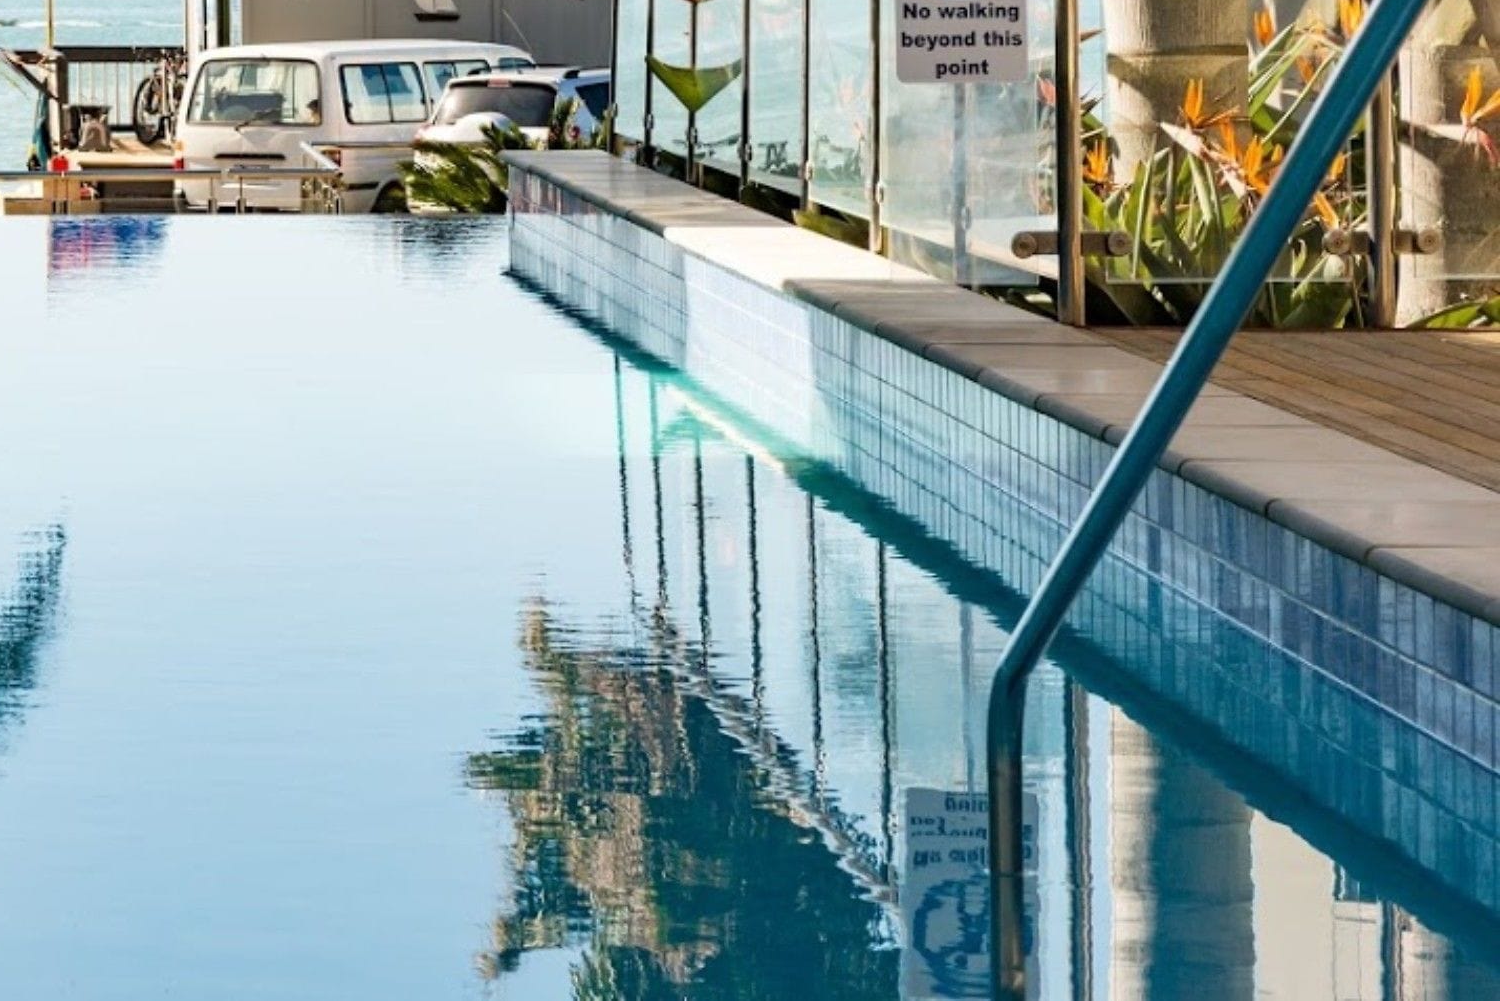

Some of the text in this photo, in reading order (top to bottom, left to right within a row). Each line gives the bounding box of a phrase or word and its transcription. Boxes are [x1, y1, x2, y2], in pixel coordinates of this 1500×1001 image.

[903, 2, 1020, 23] No walking
[901, 30, 1023, 51] beyond this
[936, 59, 989, 79] point
